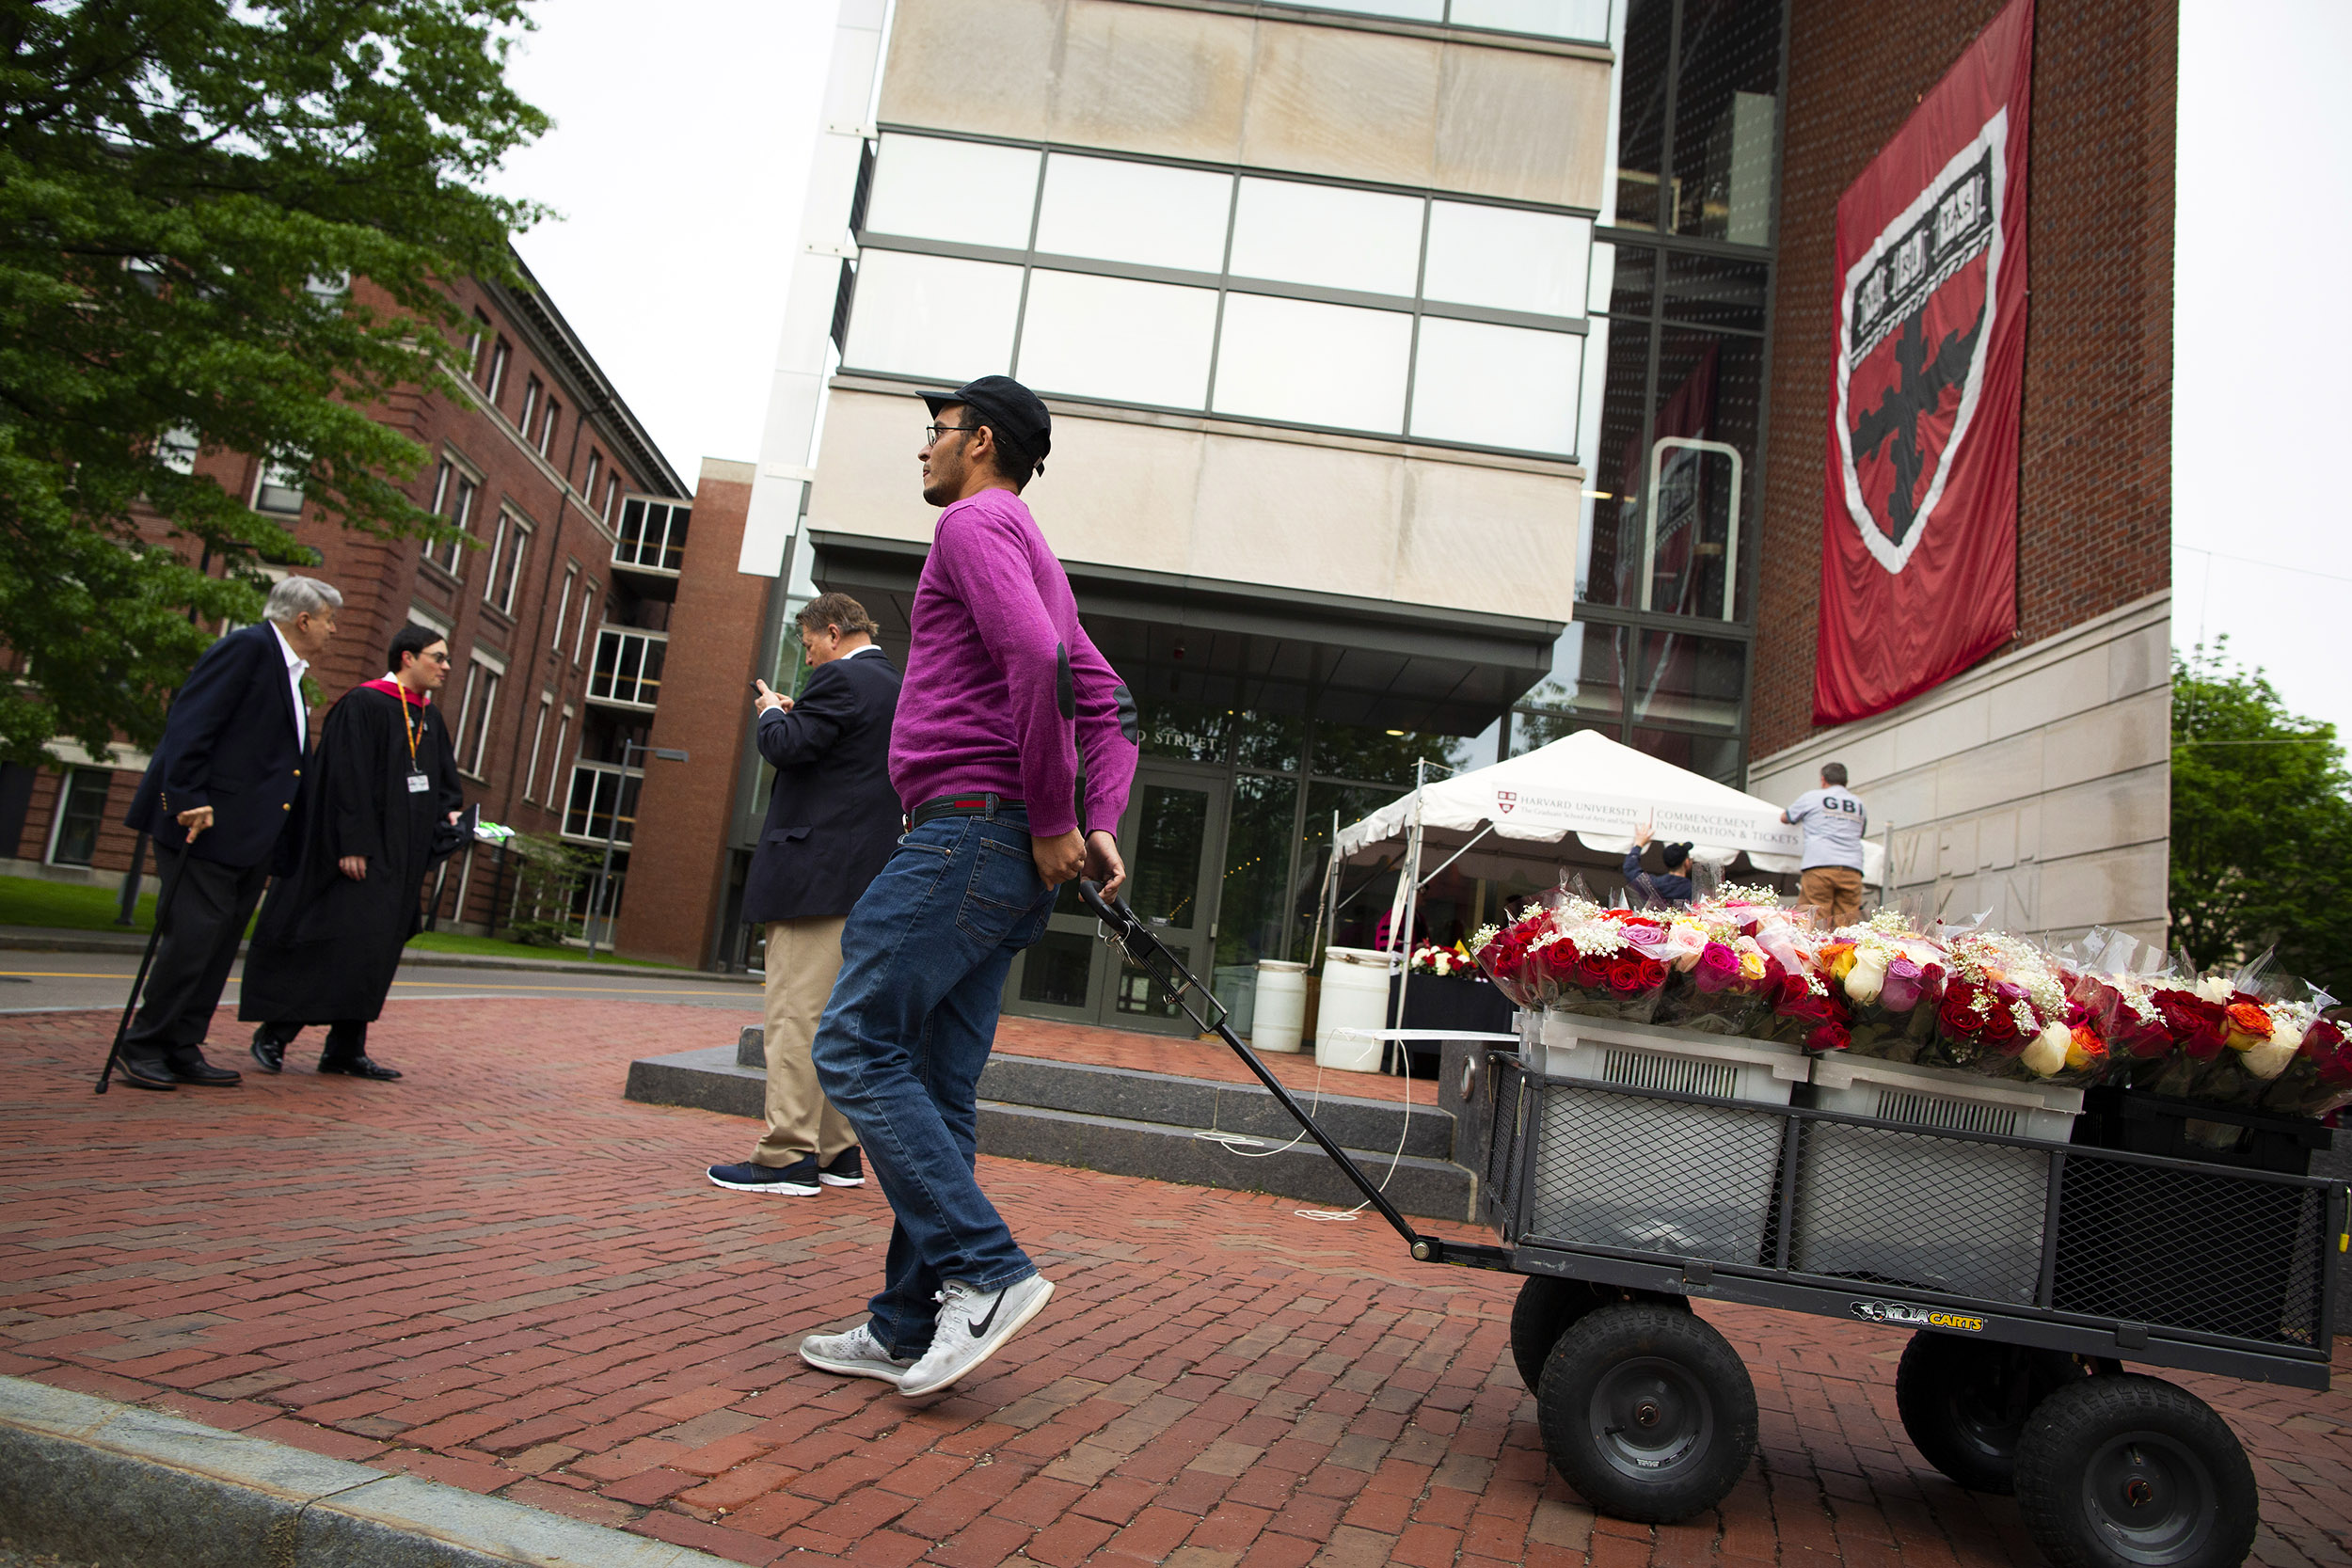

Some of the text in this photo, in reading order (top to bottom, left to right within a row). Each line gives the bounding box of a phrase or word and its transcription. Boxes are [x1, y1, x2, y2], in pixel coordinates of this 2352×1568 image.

[1154, 731, 1217, 750] STREET
[1520, 796, 1639, 817] HARVARD UNIVERSITY
[1657, 810, 1756, 829] COMMENCEMENT
[1656, 820, 1736, 837] INFORMATION
[1753, 831, 1799, 845] TICKETS
[1929, 1312, 1982, 1330] CARTS
